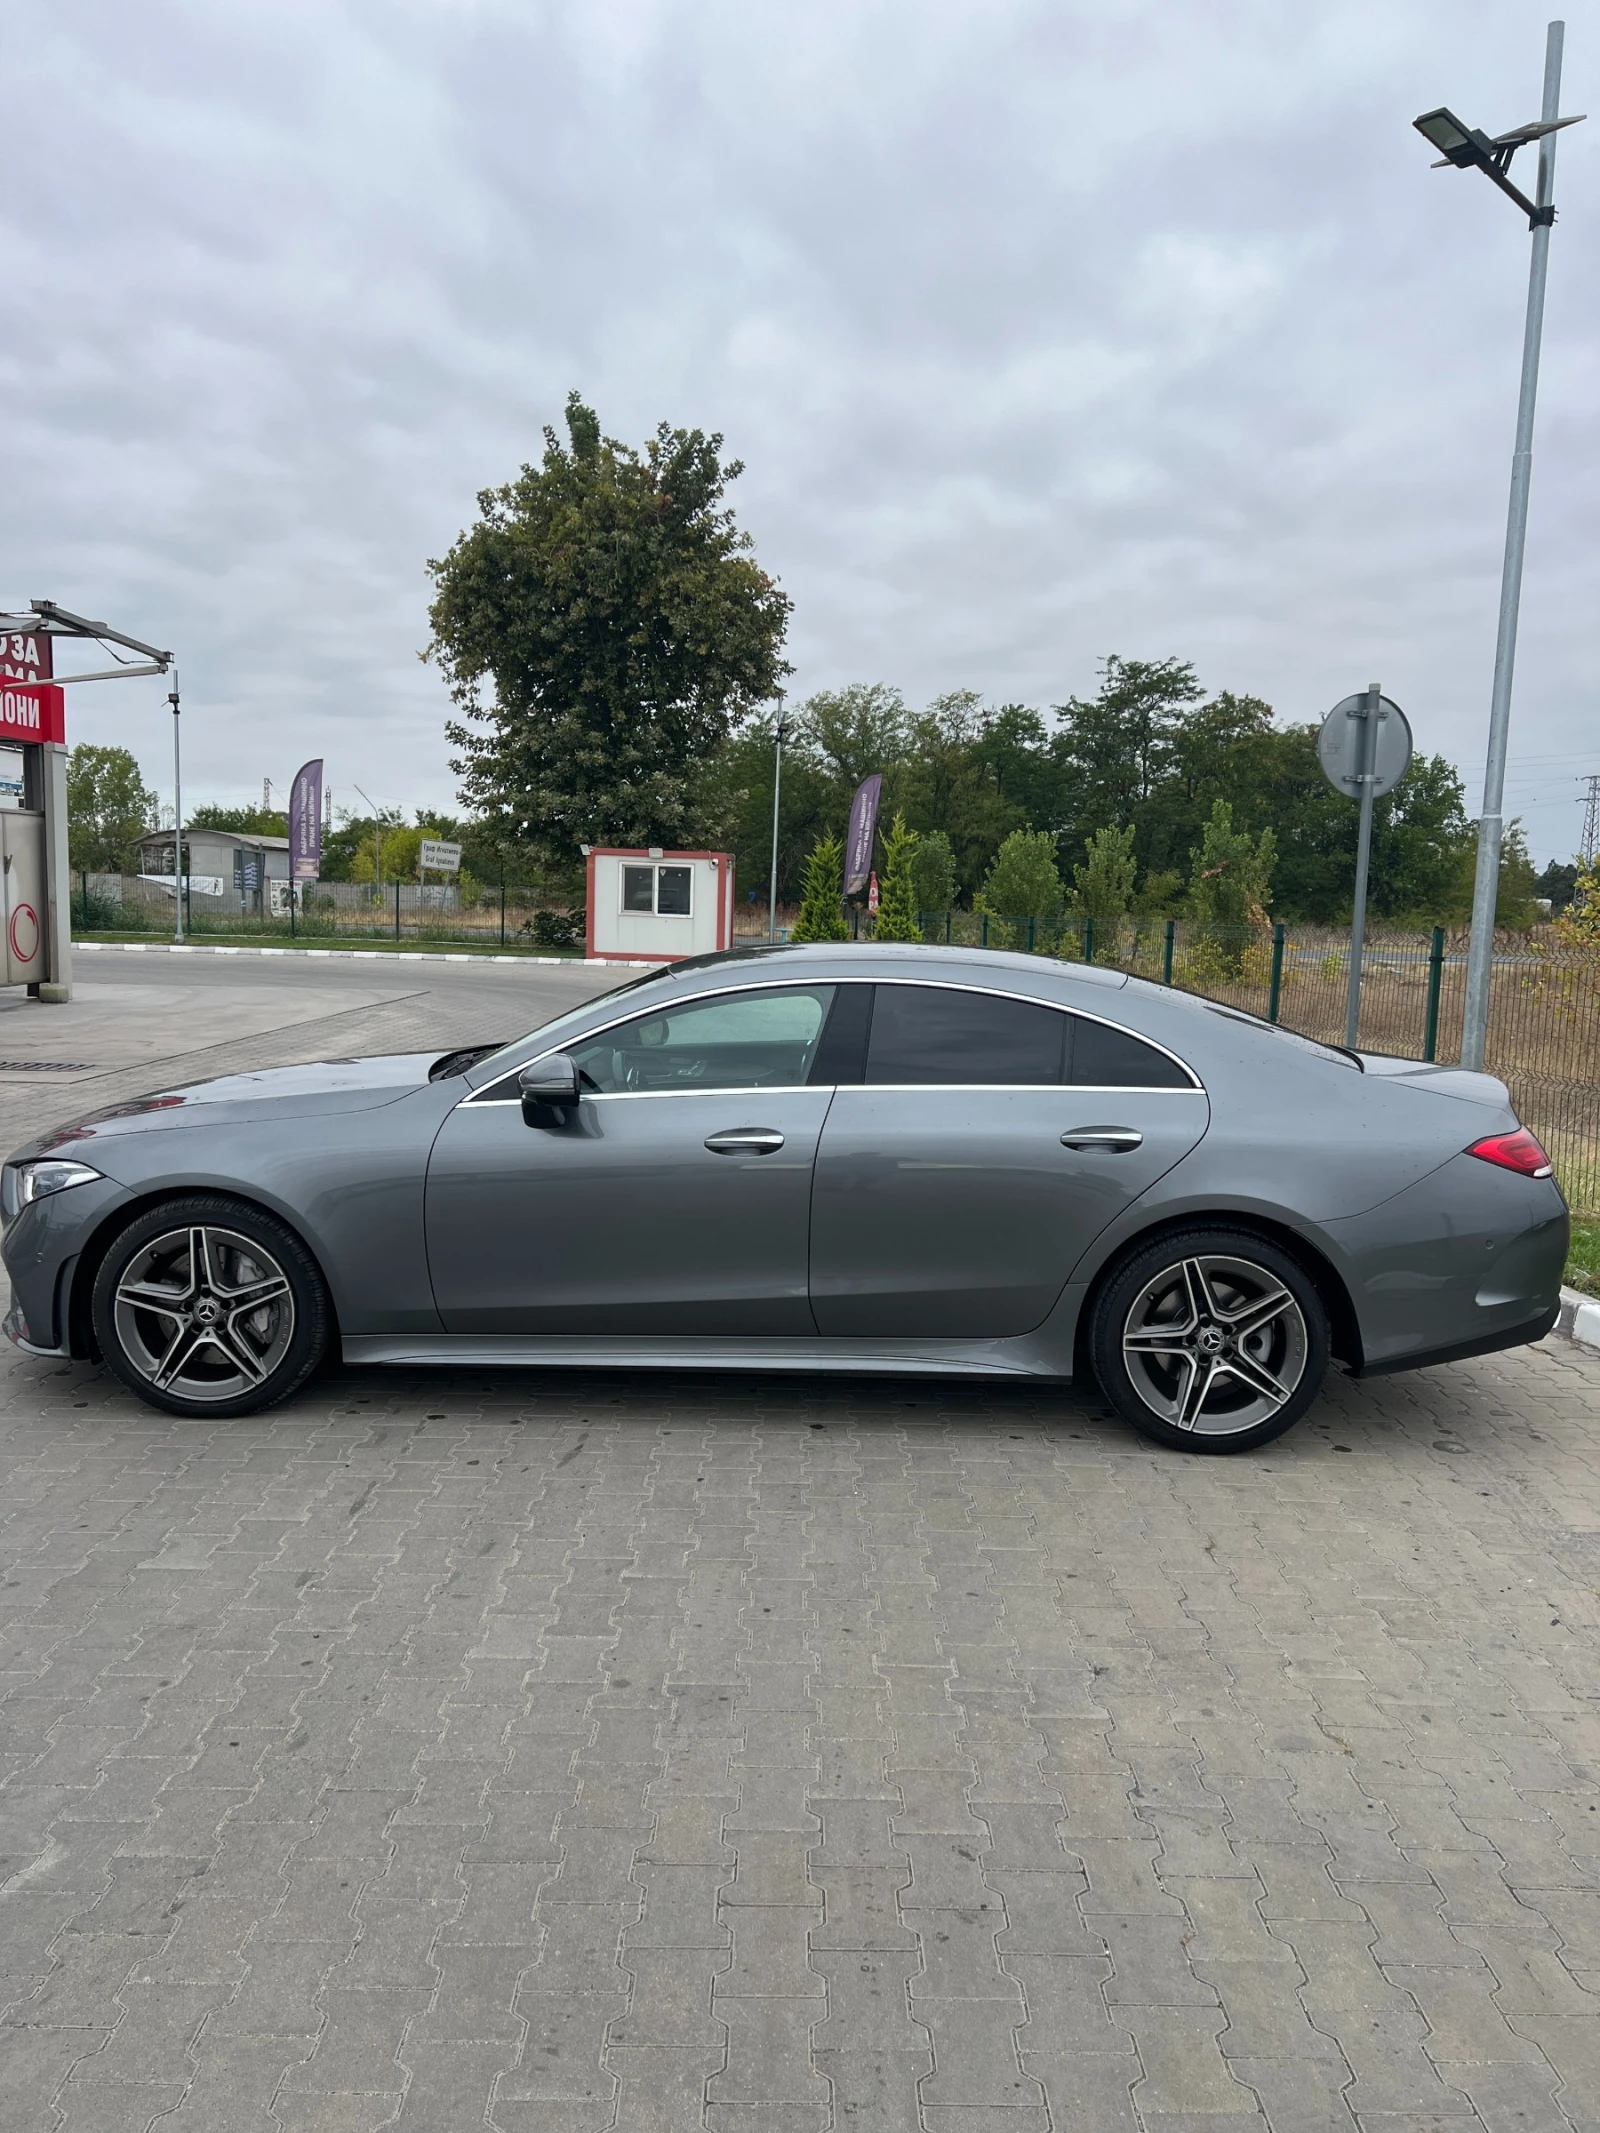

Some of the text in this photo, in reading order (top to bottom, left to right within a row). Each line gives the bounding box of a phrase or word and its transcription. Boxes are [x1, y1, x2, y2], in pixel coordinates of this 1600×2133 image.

[11, 634, 40, 666] ЗА
[308, 816, 315, 825] НА
[300, 822, 308, 855] ФАБРИКА
[308, 826, 316, 848] ПРАНЕ
